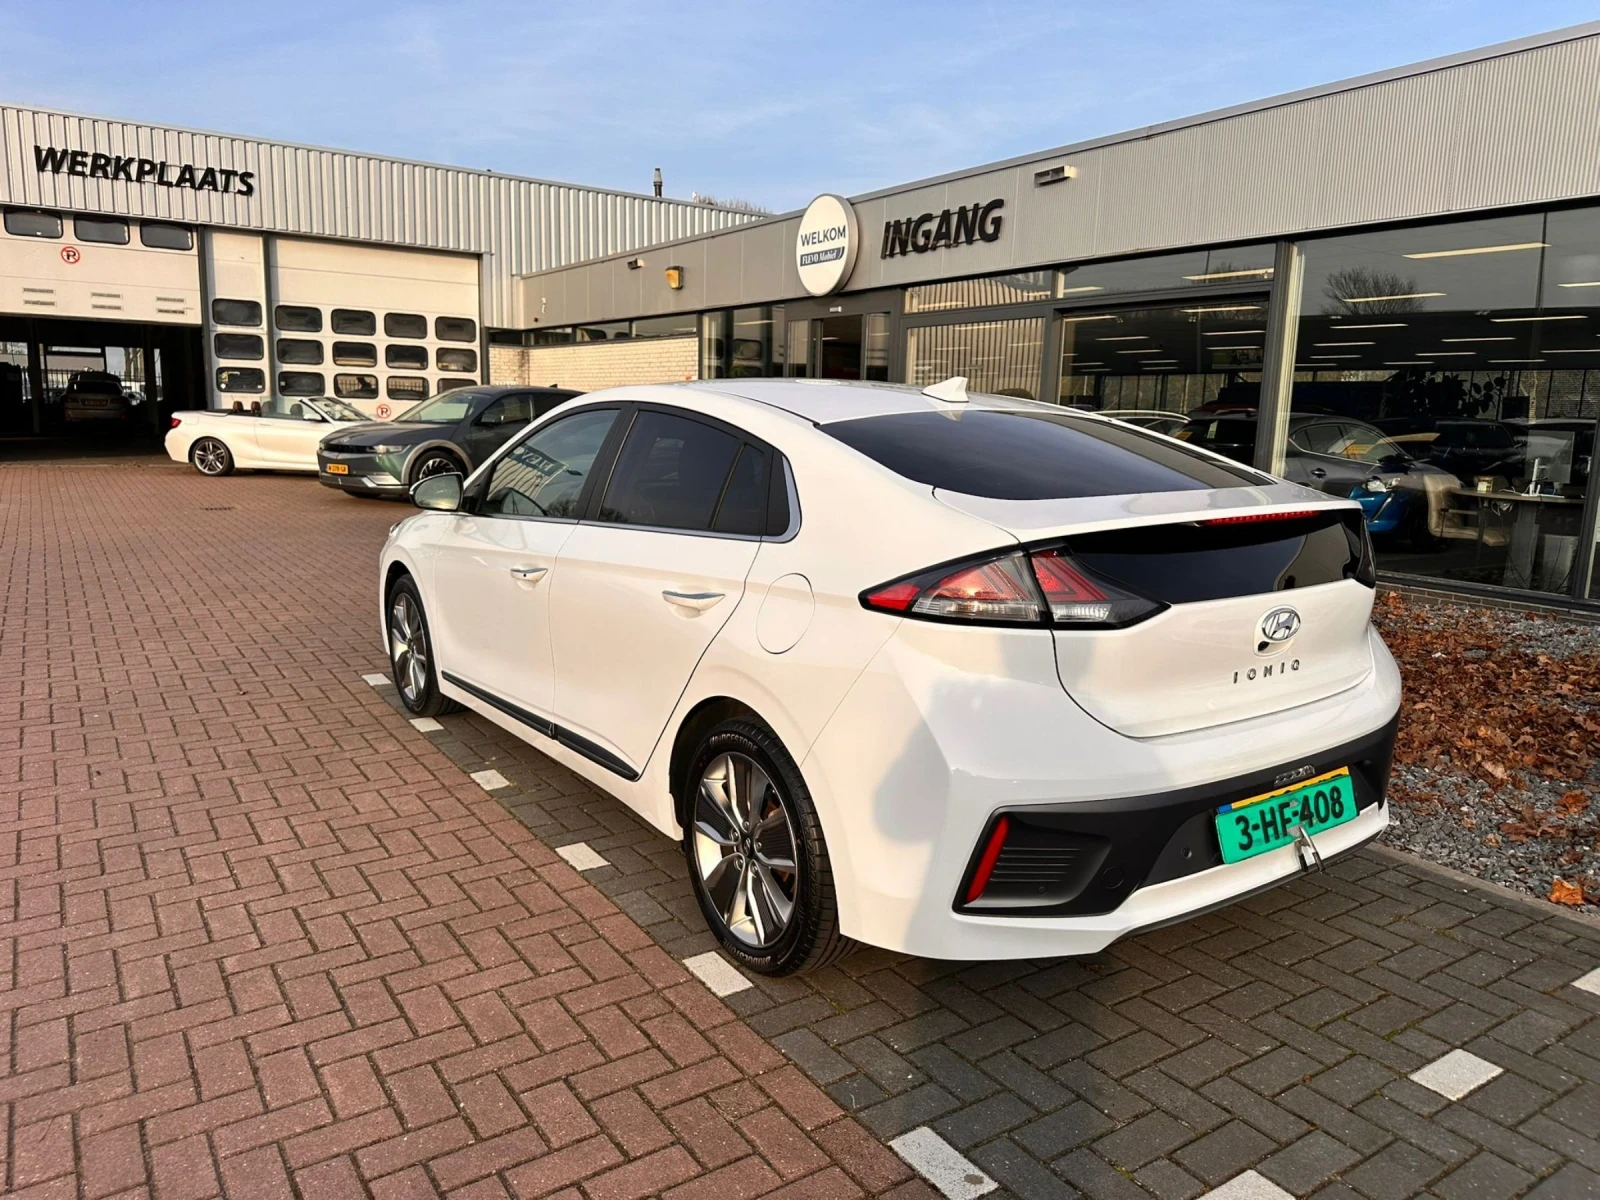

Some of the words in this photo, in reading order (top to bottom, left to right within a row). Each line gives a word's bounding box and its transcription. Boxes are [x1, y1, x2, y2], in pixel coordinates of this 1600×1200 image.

[33, 145, 255, 197] WERKPLAATS
[801, 225, 846, 247] WELKOM
[880, 198, 1005, 260] INGANG
[802, 253, 819, 265] FLEVO
[819, 249, 838, 262] Mobiel
[1233, 659, 1300, 684] IONIQ
[1235, 785, 1345, 851] 3-HF-408
